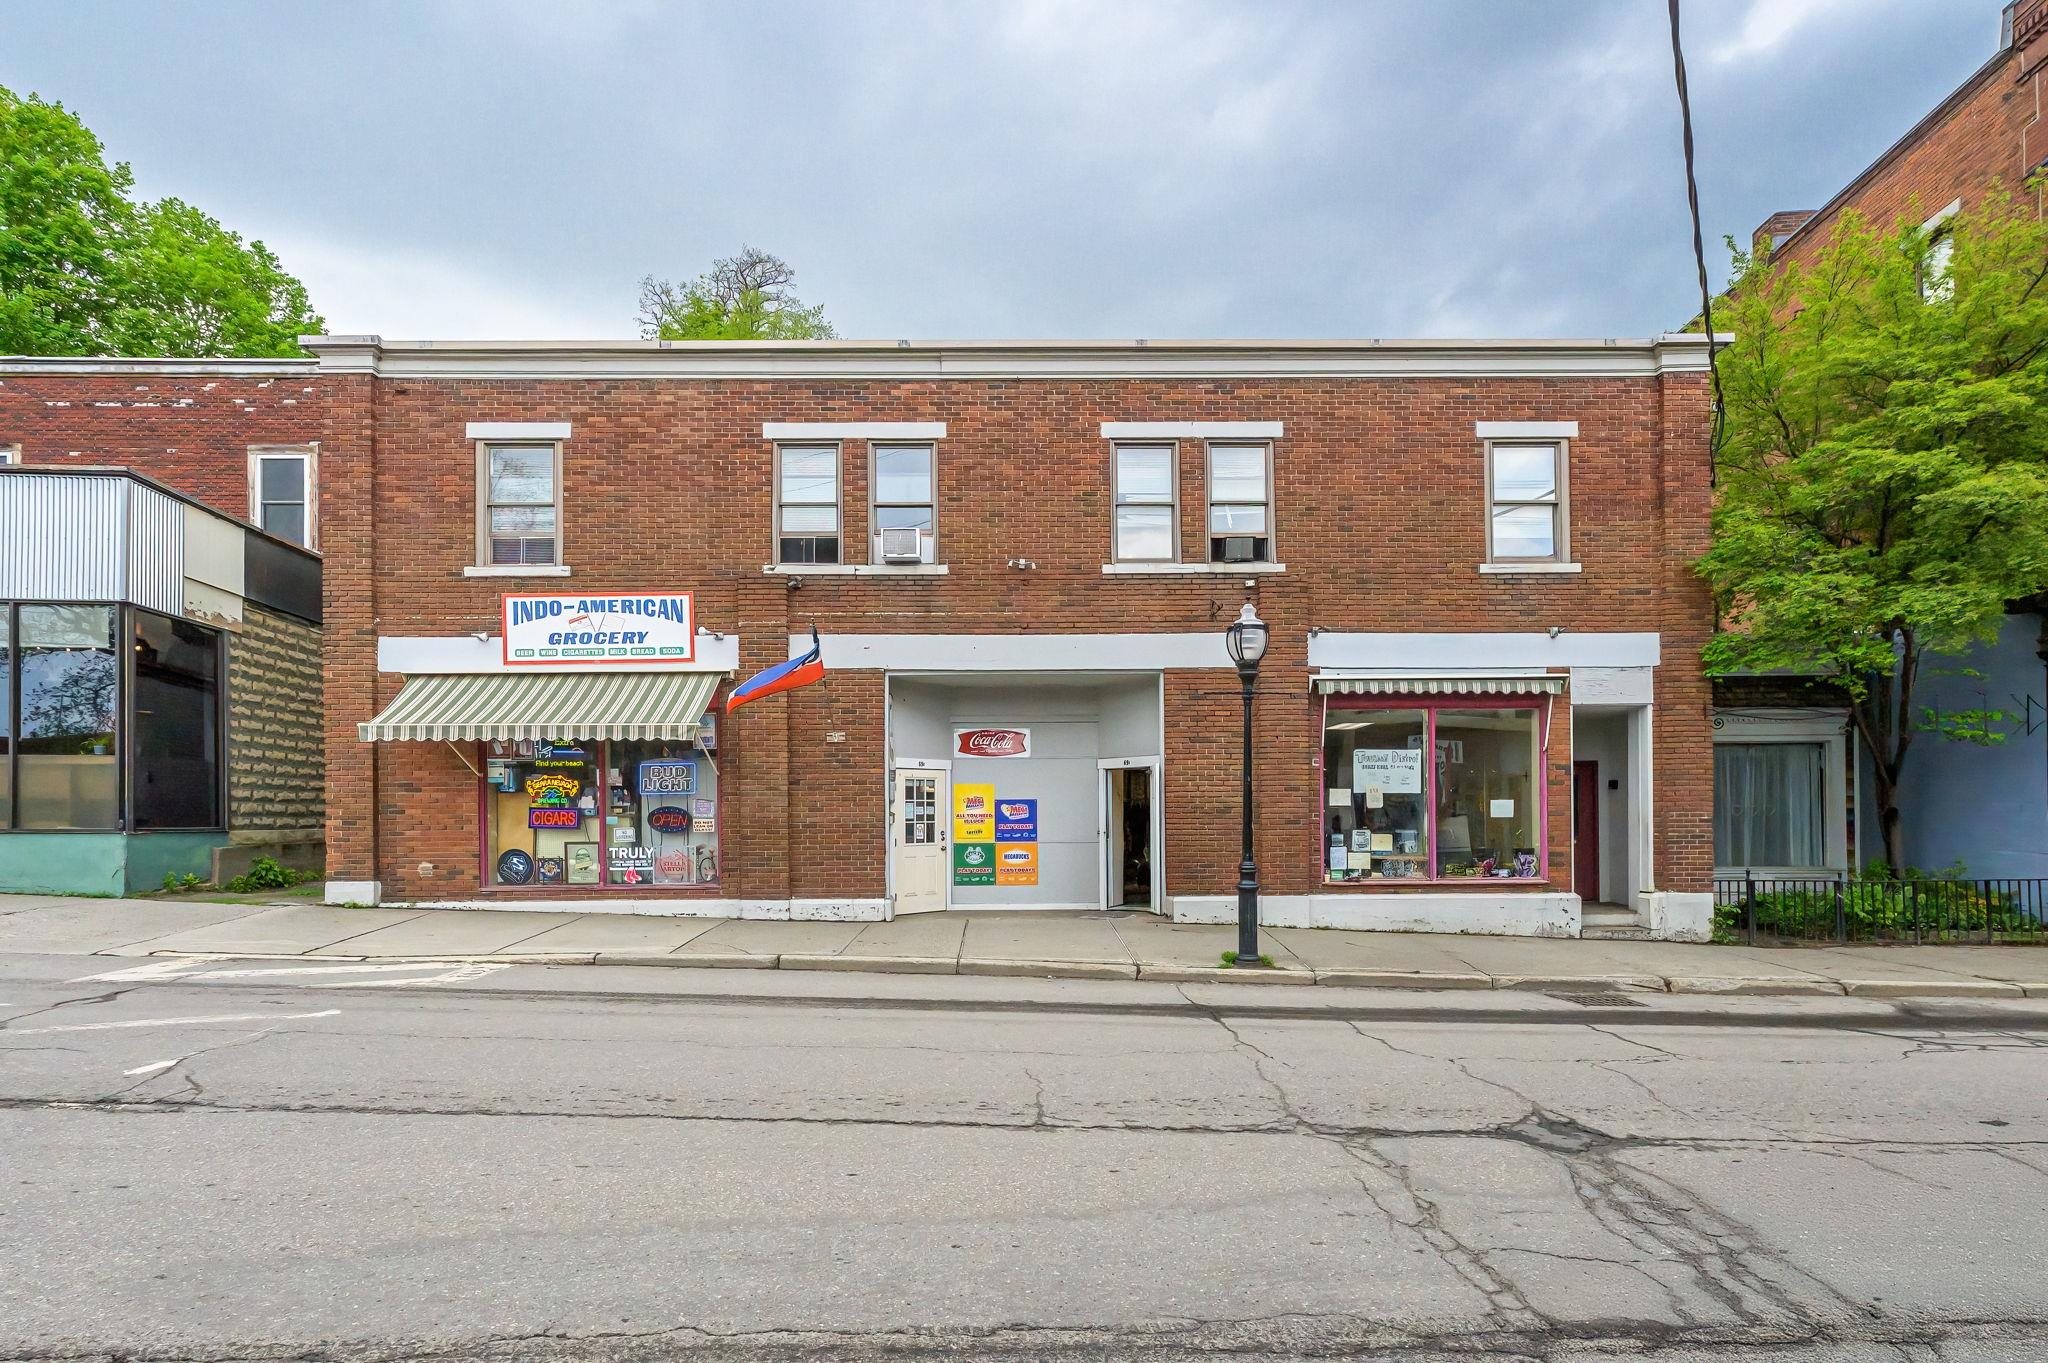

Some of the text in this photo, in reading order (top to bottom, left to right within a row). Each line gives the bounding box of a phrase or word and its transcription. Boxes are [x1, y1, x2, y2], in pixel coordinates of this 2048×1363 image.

[513, 599, 684, 625] INDO-AMERICAN
[549, 631, 648, 645] GROCERY
[563, 648, 604, 656] CIGARETTES
[662, 647, 681, 655] SODA
[969, 732, 1016, 749] Coca-Cola
[651, 765, 687, 779] BUD
[643, 778, 694, 791] LIGHT
[532, 811, 576, 825] CIGARS
[652, 814, 688, 827] OPEN
[609, 847, 654, 859] TRULY
